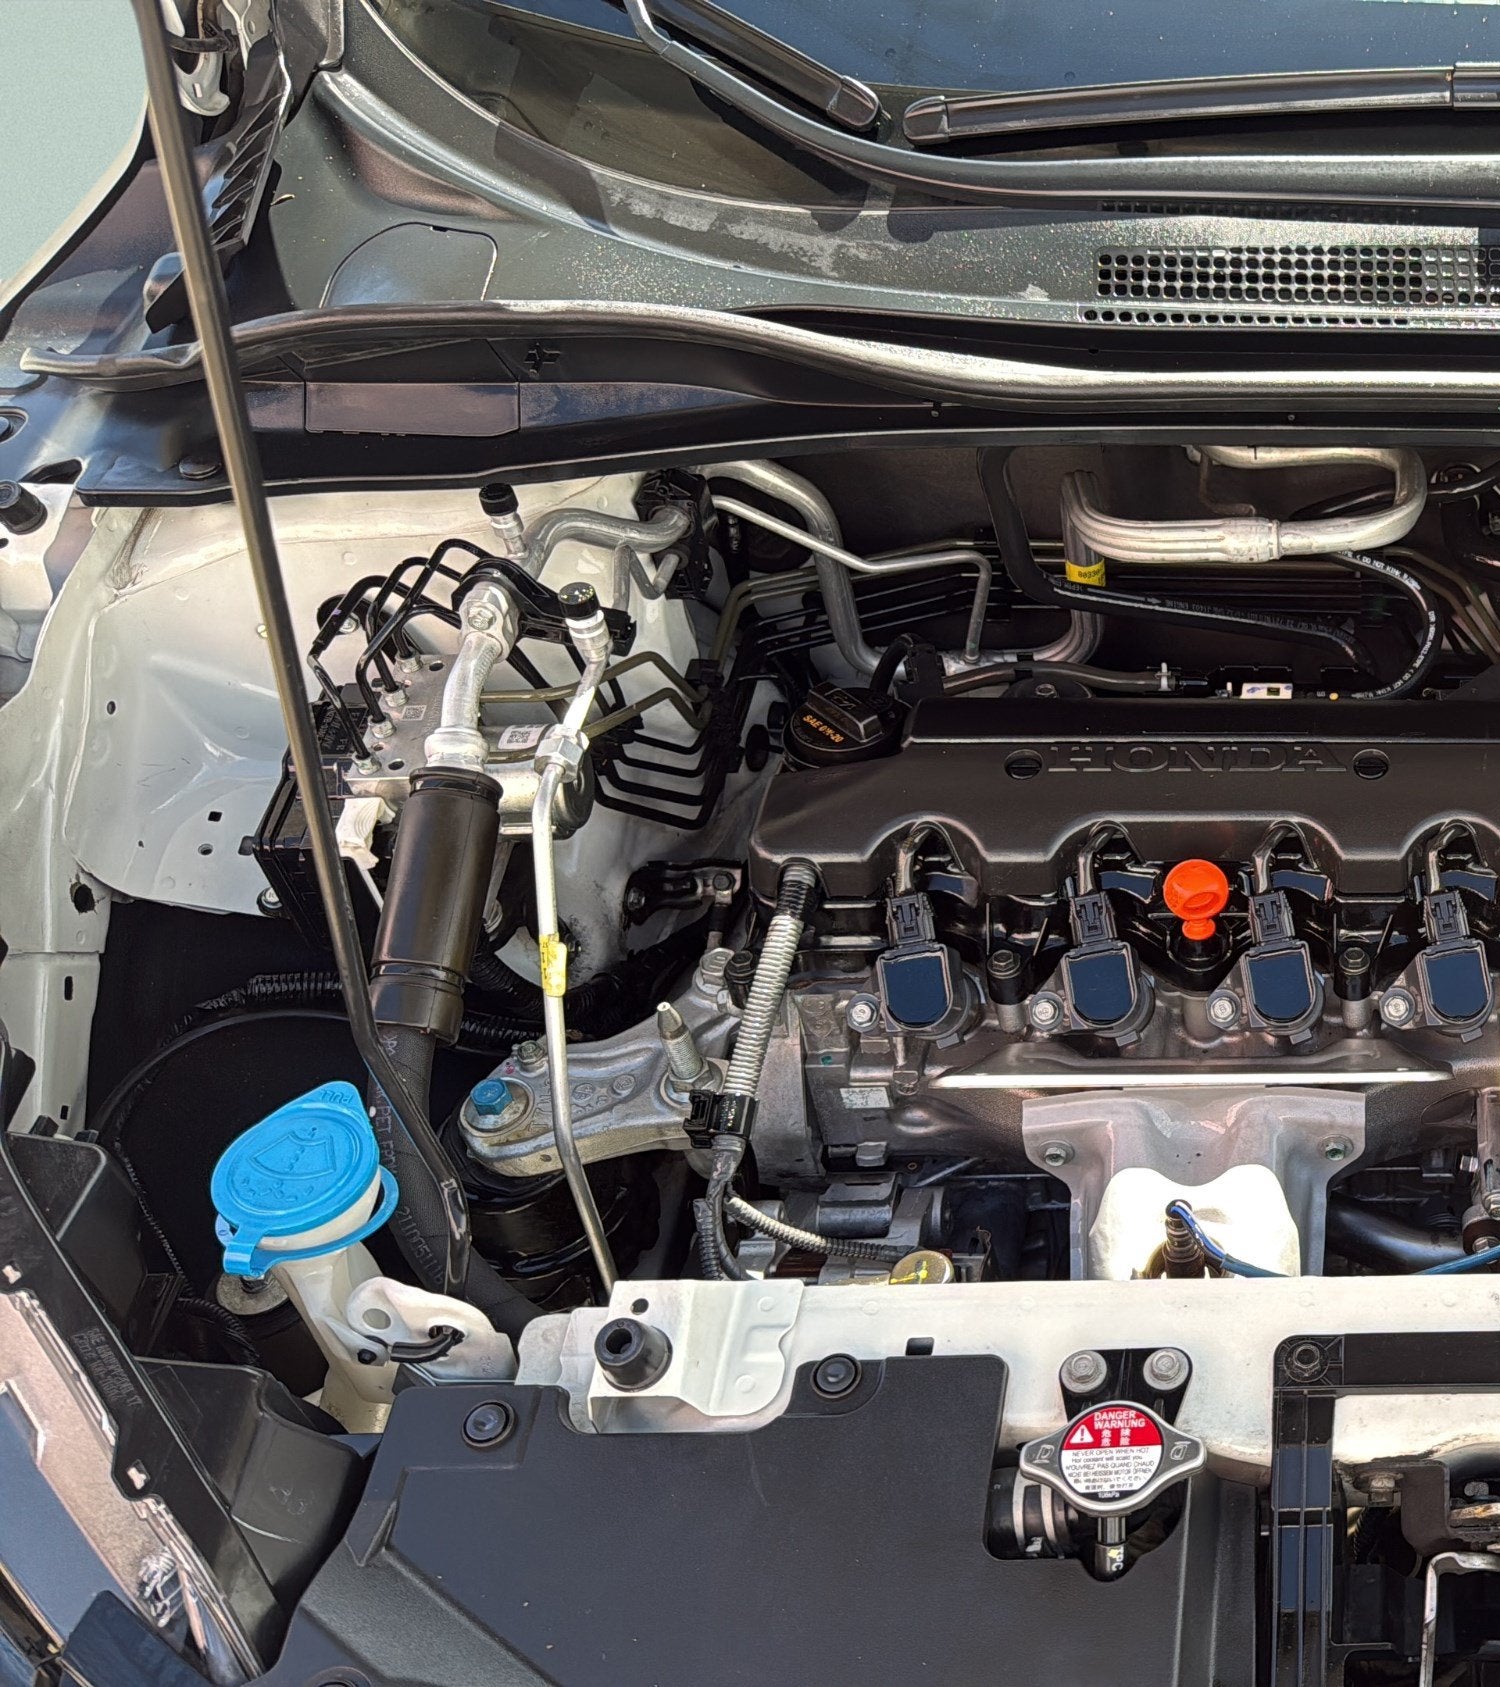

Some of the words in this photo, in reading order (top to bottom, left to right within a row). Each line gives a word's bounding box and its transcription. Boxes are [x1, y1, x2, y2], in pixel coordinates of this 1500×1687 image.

[803, 715, 822, 728] SAE
[1048, 746, 1347, 772] HONDA
[321, 1089, 353, 1104] PULL
[1094, 1410, 1135, 1420] DANGER
[1110, 1460, 1132, 1468] QUAND
